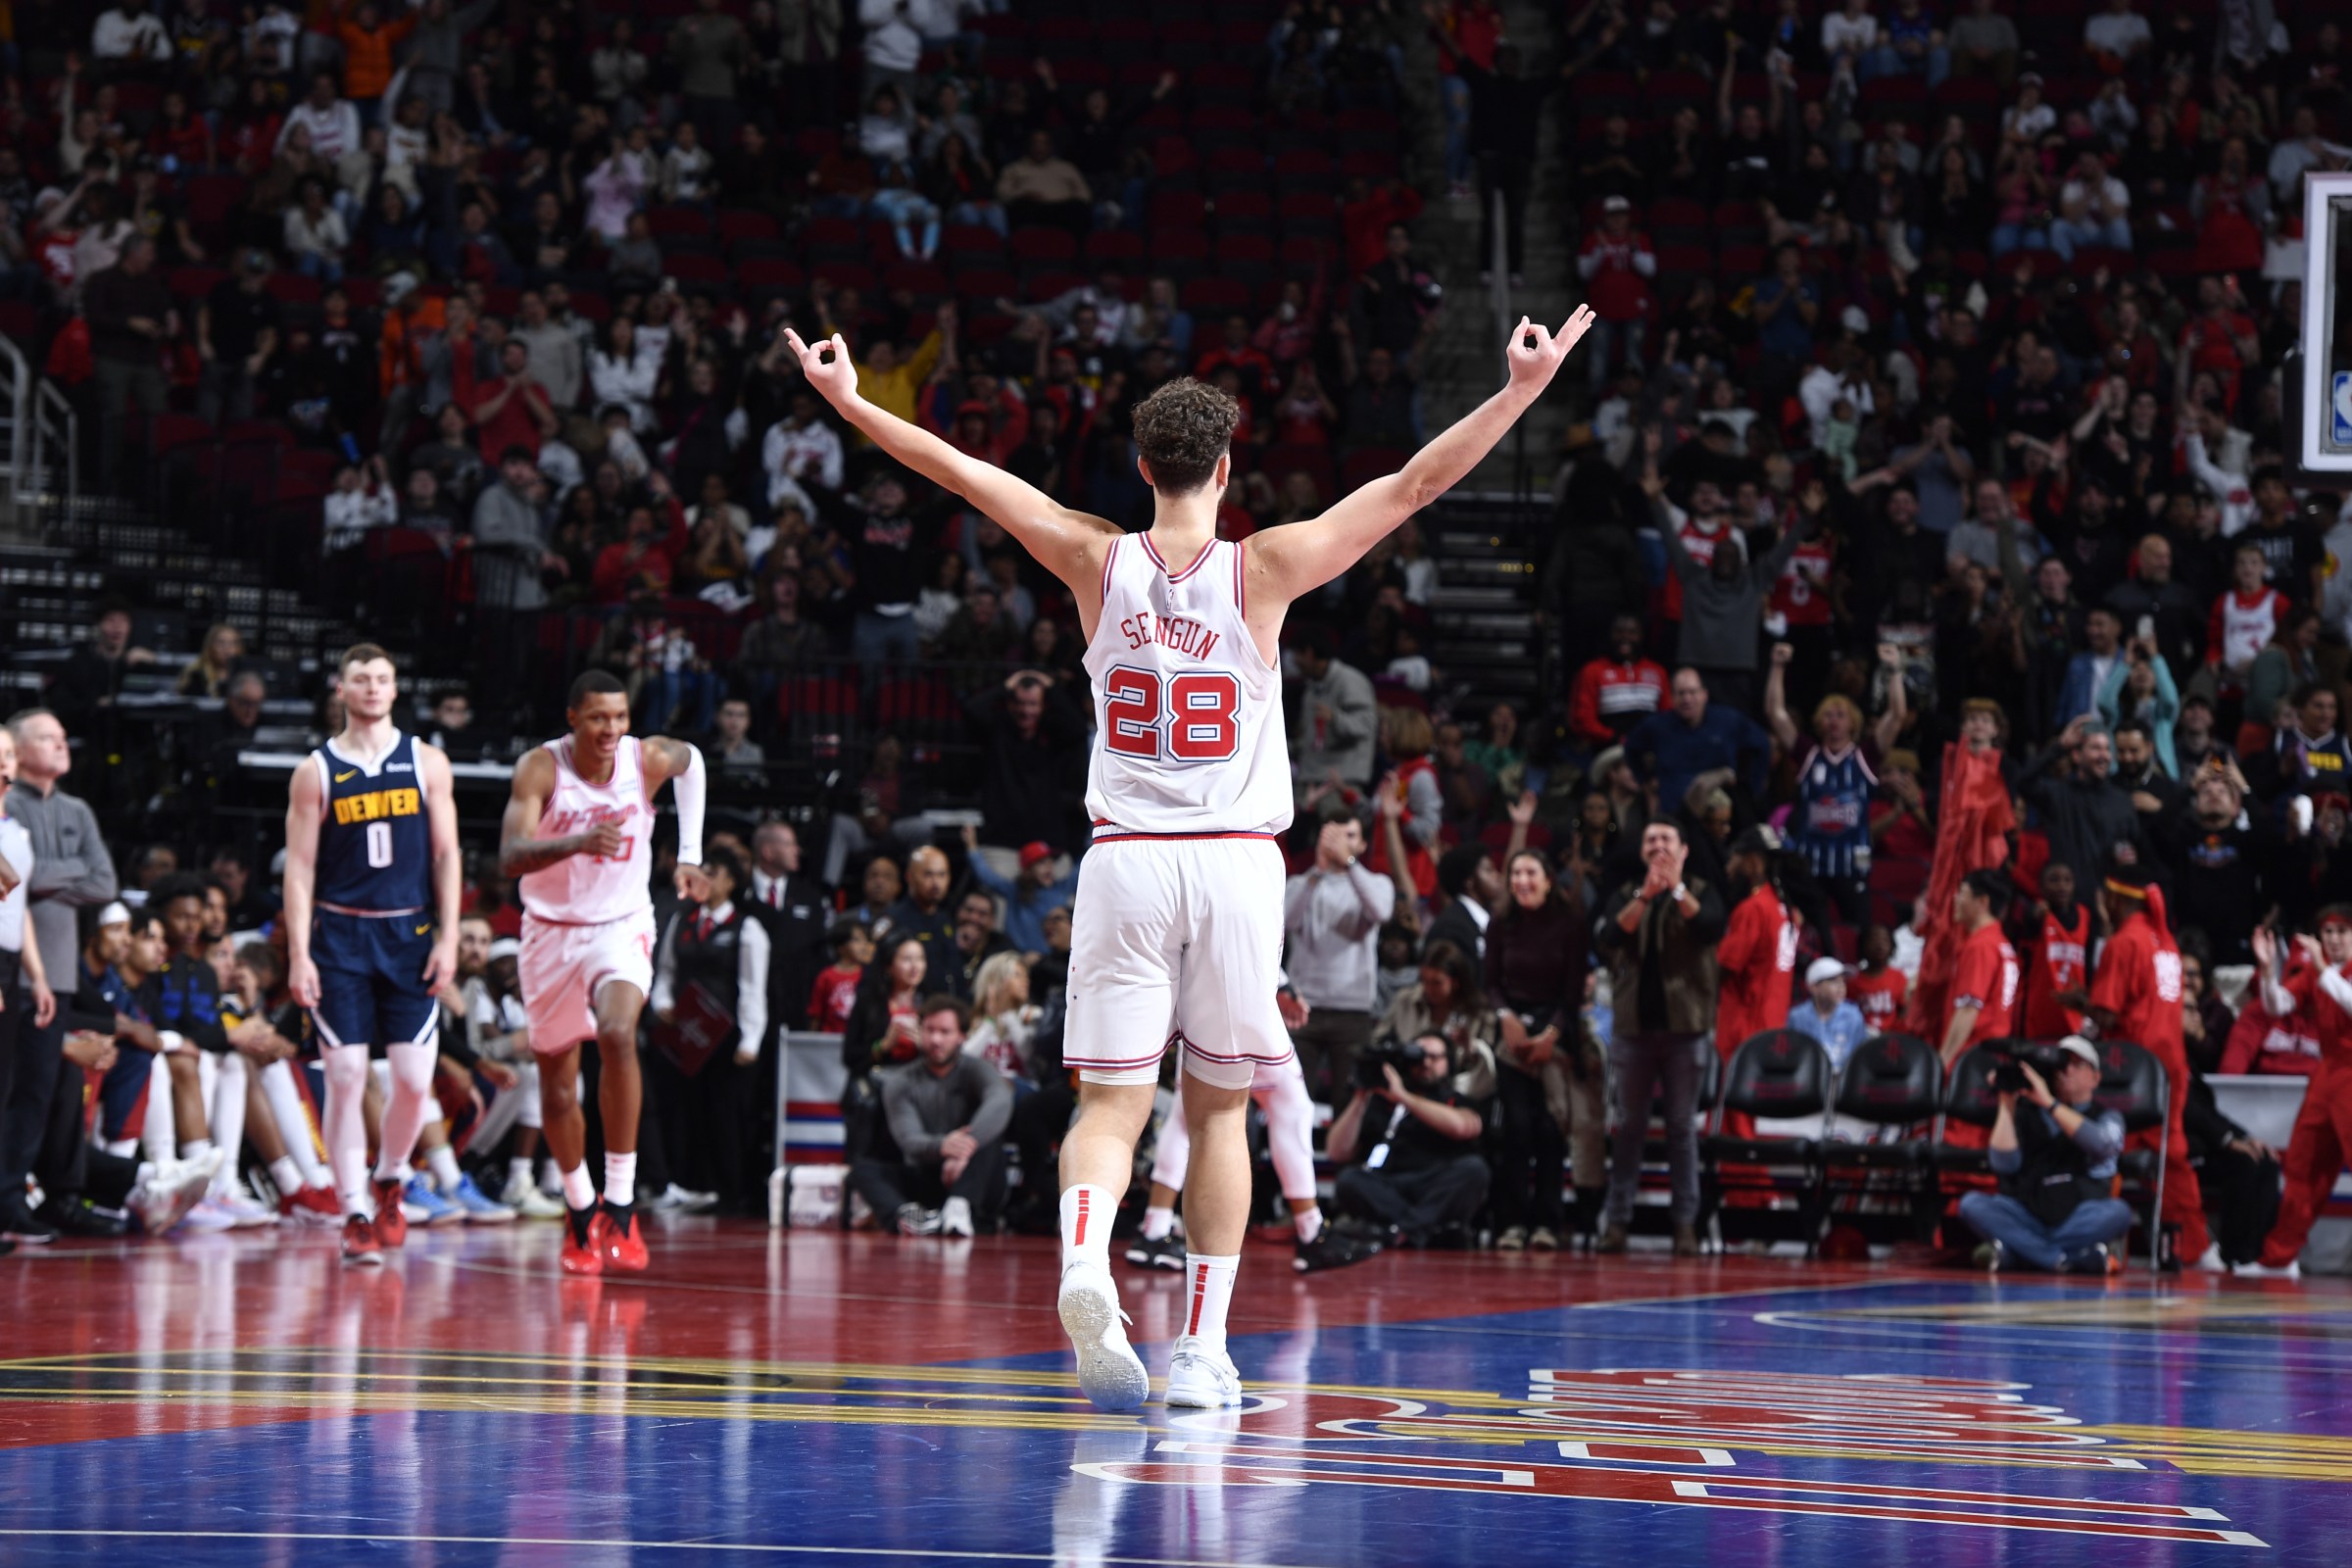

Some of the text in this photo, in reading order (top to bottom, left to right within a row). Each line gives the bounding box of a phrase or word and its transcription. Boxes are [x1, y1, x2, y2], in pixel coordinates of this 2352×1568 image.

[1120, 612, 1220, 662] SENGUN
[1103, 663, 1242, 762] 28
[333, 787, 420, 825] DENVER
[367, 821, 393, 868] 0
